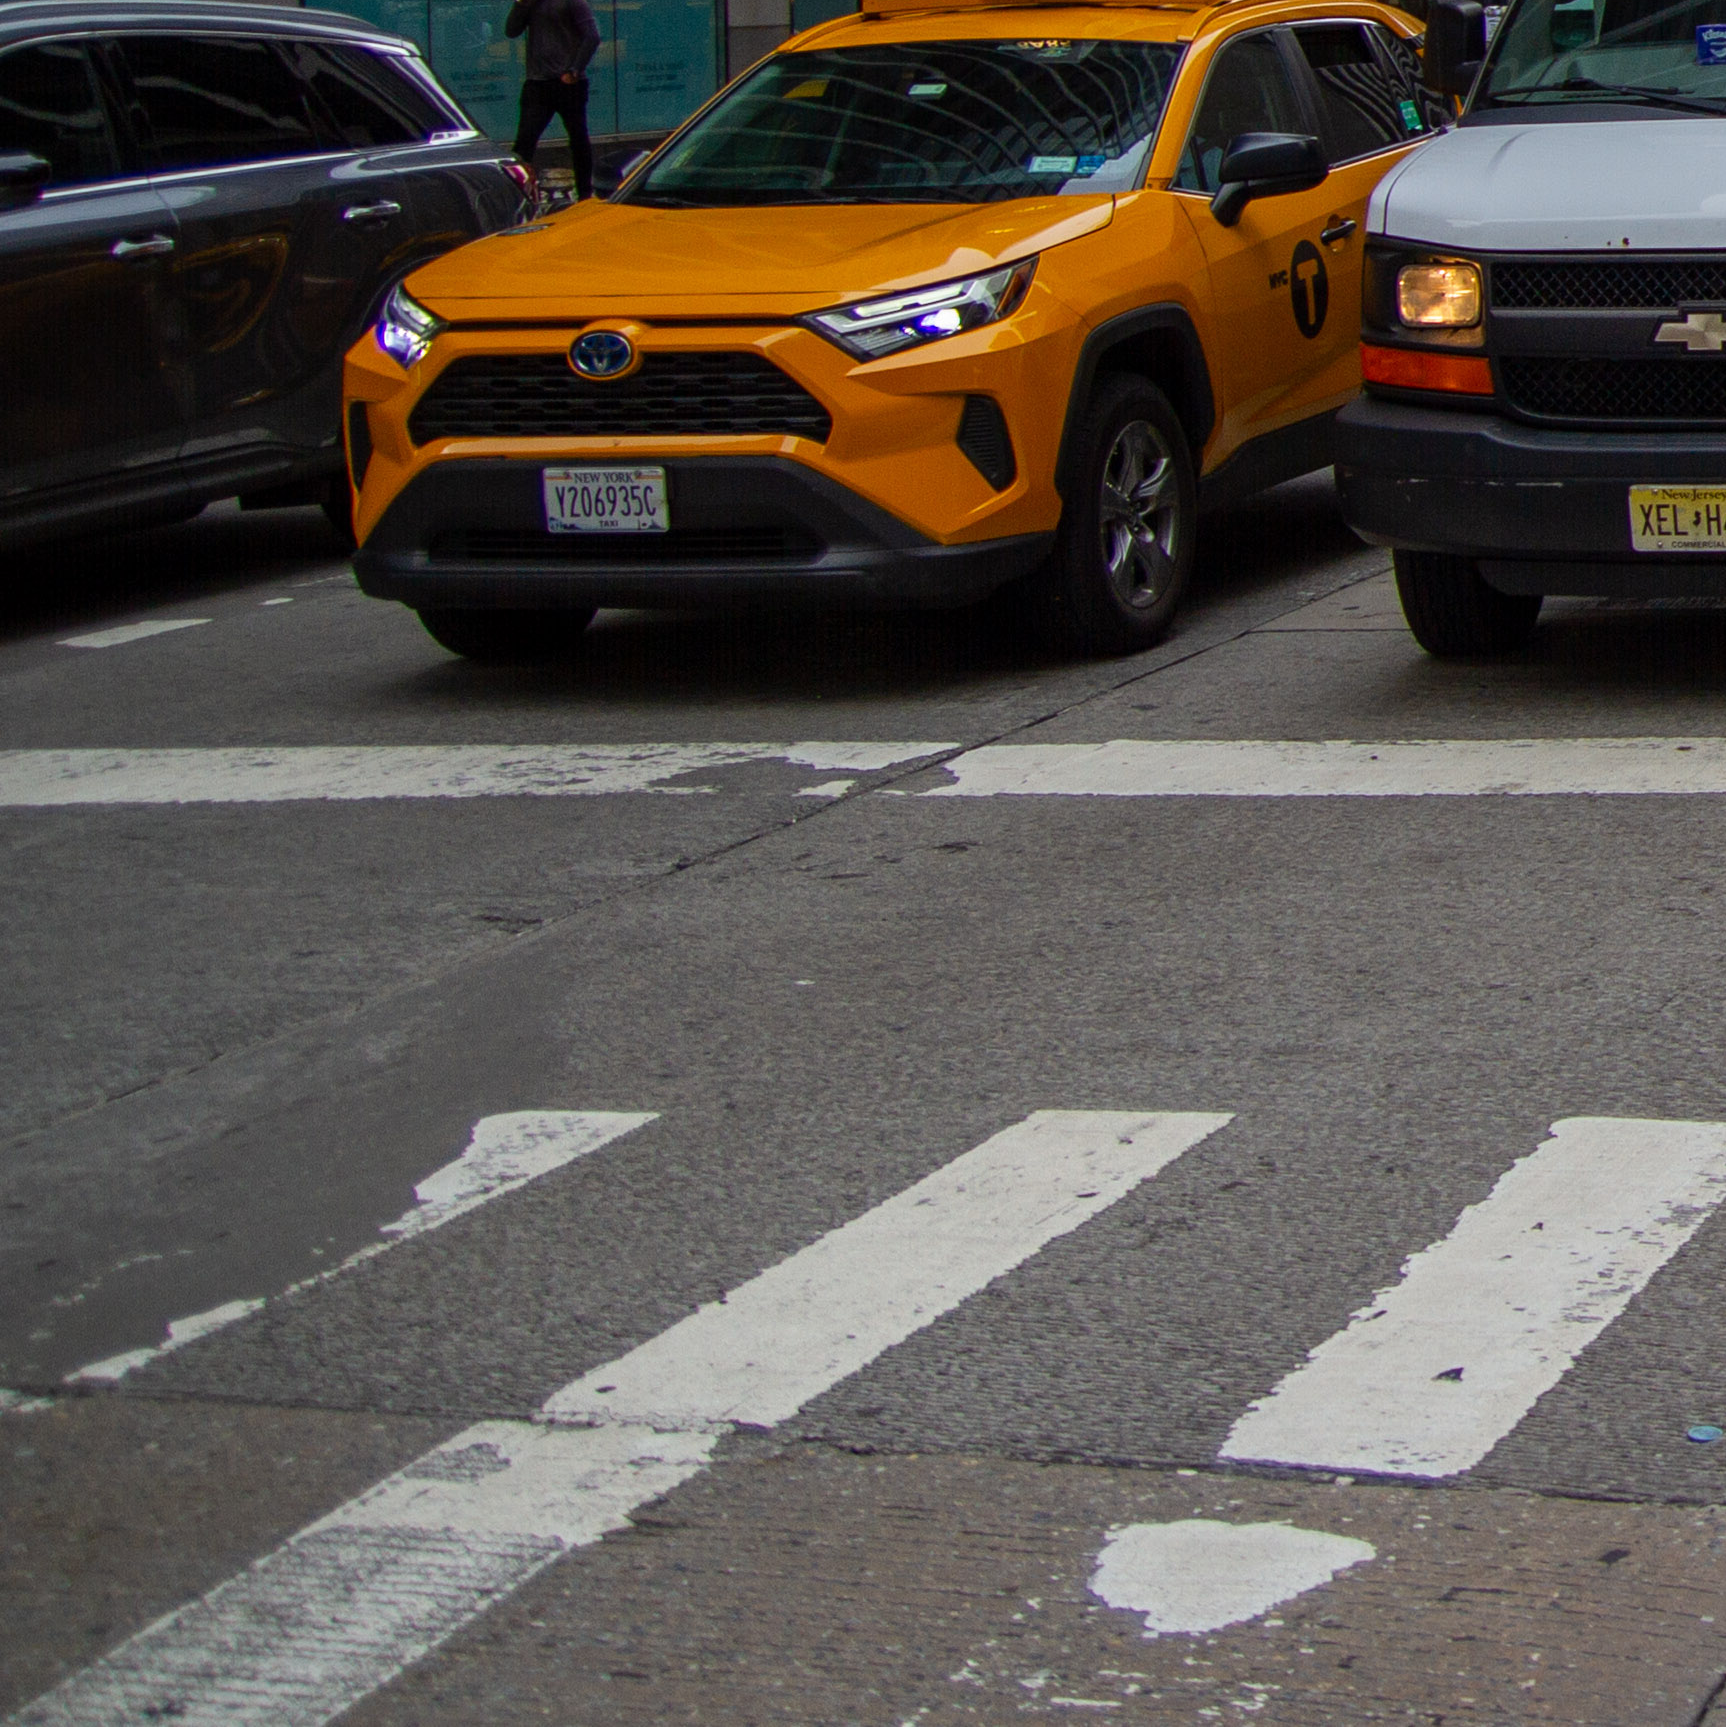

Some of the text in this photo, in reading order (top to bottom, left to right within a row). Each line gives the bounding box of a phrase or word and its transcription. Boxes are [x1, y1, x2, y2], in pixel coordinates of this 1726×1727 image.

[1269, 270, 1288, 290] NYC
[1296, 258, 1319, 325] T
[573, 472, 634, 484] NEW YORK
[555, 485, 656, 517] Y206935C
[1662, 489, 1690, 499] New
[1640, 504, 1689, 536] XEL
[1671, 540, 1726, 549] COMMERCIAL
